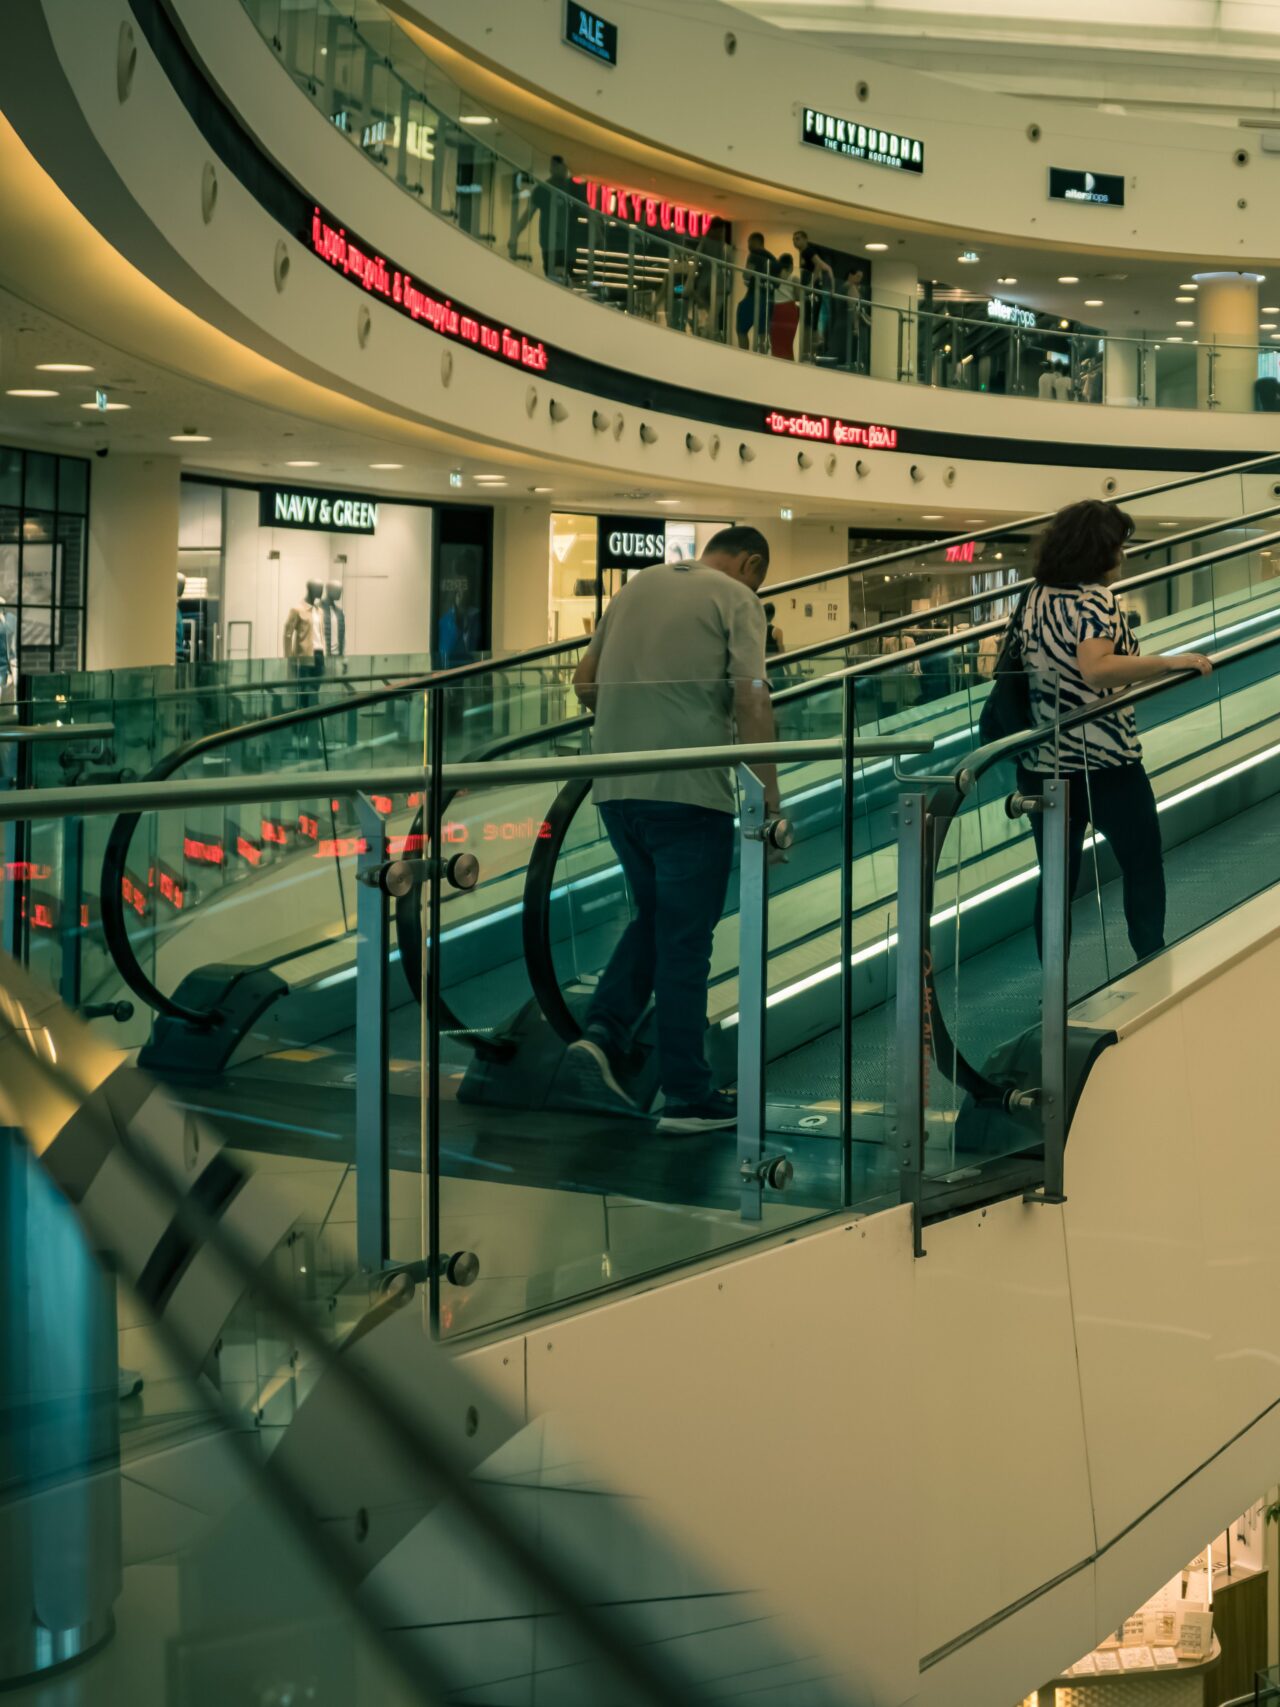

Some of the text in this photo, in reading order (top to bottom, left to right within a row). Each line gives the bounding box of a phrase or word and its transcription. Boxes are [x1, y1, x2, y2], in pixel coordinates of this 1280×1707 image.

[579, 10, 605, 47] ALE
[806, 109, 921, 163] FUNKYBUDDHA
[824, 137, 838, 150] THE
[841, 143, 865, 158] RIGHT
[275, 492, 379, 529] NAVY & GREEN
[609, 531, 664, 557] GUESS
